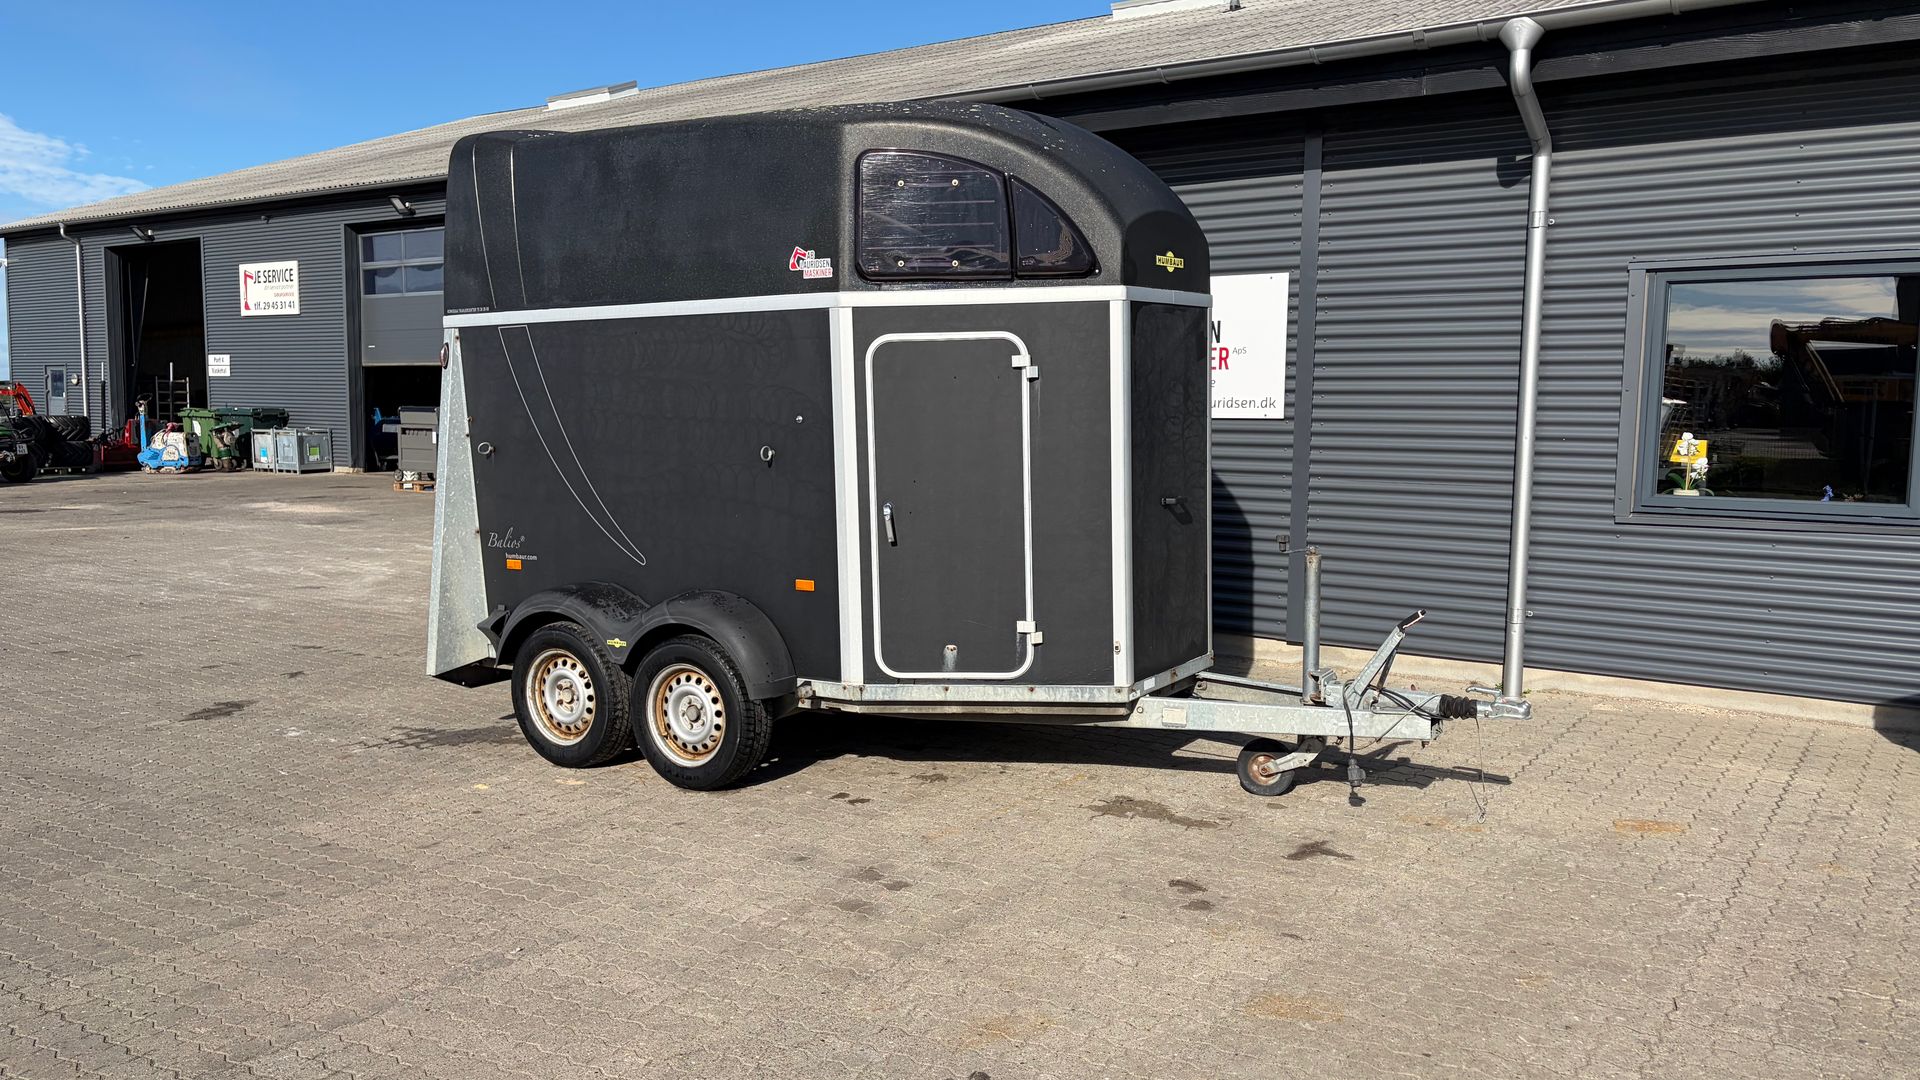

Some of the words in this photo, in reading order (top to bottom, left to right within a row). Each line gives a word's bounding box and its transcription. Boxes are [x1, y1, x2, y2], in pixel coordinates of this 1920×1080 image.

[1157, 256, 1183, 267] HUMBAUR
[254, 270, 261, 284] JE
[263, 268, 294, 283] SERVICE
[804, 268, 832, 277] MASKINER
[263, 301, 270, 310] 29
[271, 301, 278, 310] 45
[280, 301, 287, 309] 31
[288, 300, 295, 309] 41
[1232, 347, 1247, 356] ApS
[505, 552, 538, 561] humbaur.com
